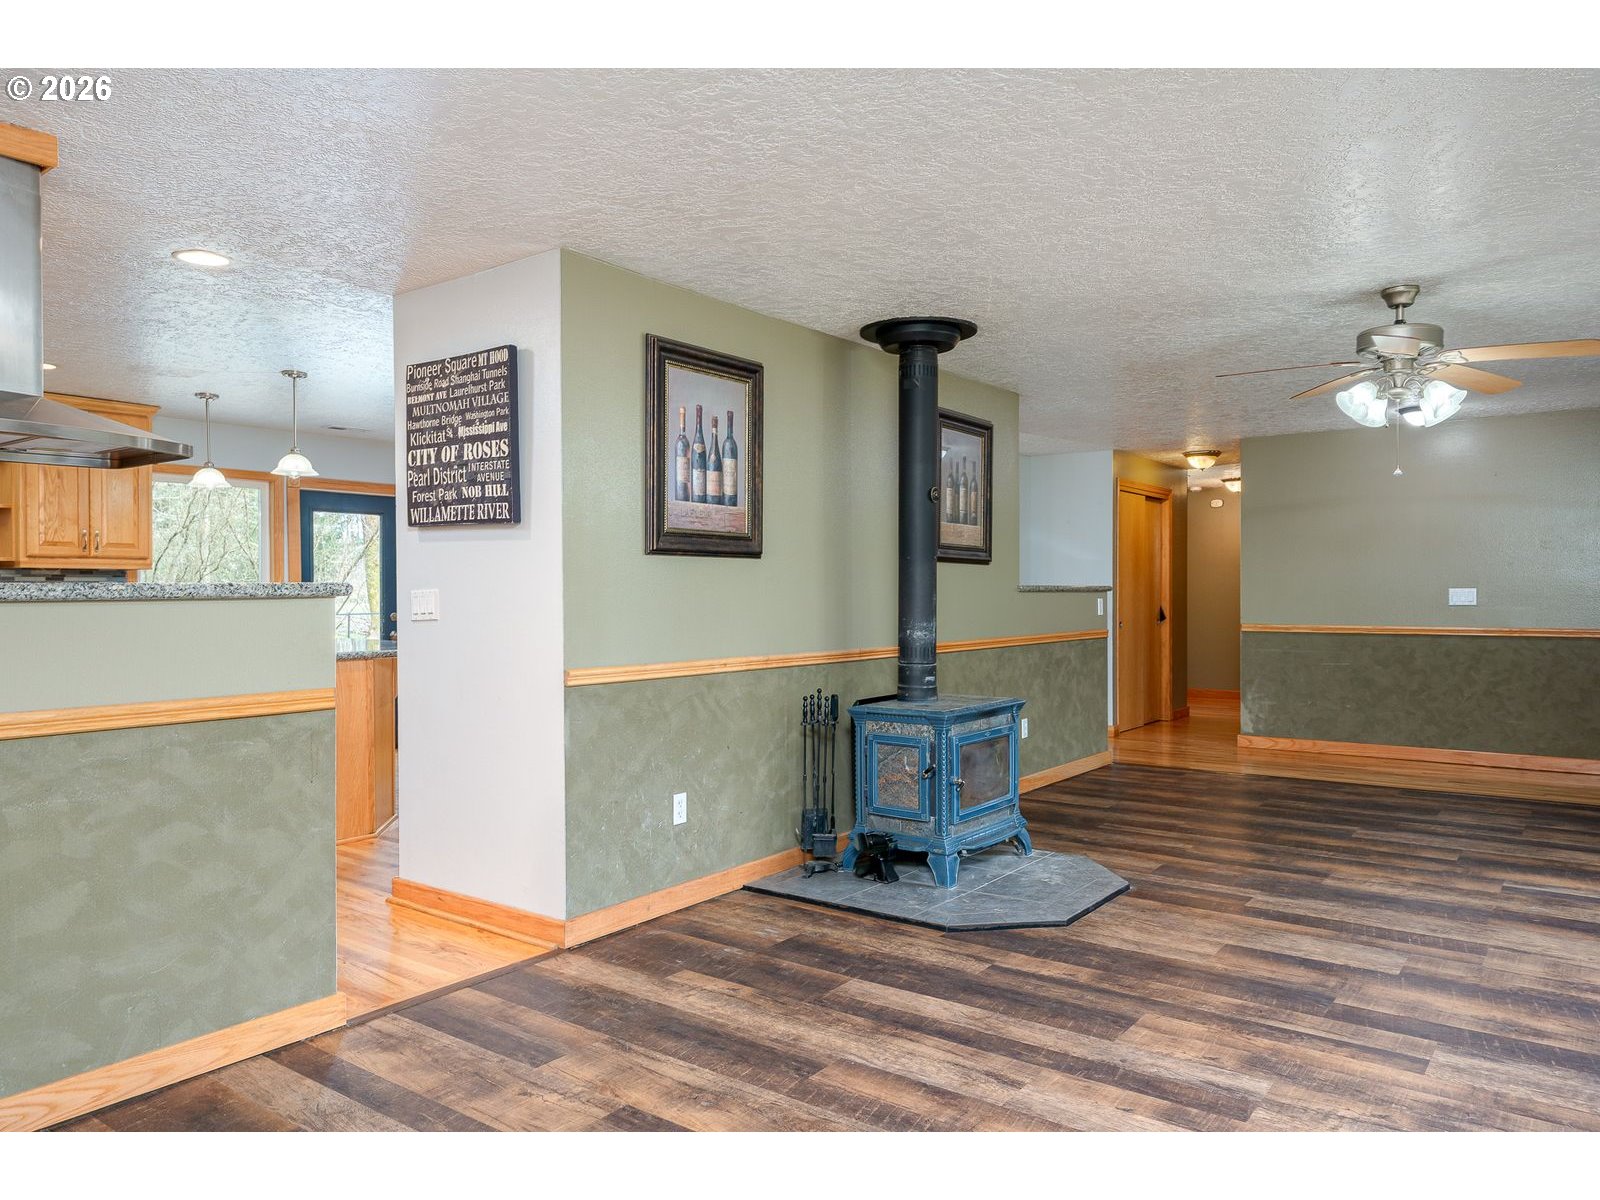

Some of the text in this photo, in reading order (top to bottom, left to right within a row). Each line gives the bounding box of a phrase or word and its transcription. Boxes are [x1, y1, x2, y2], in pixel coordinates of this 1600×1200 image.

[407, 348, 509, 380] Pioneer Square MT HOOD
[434, 376, 450, 388] Road
[450, 370, 480, 385] Shanghai
[482, 365, 508, 380] Tunnels
[407, 379, 506, 405] BELMONT AVE Laurelhurst Park
[412, 392, 510, 418] MULTNOMAH VILLAGE
[407, 407, 510, 431] Hawthorne Bridge Washington Park
[410, 430, 446, 446] Klickitat
[458, 421, 495, 439] Mississippi
[496, 421, 508, 432] Ave
[408, 438, 509, 467] CITY OF ROSES
[407, 464, 467, 488] Pearl District
[468, 459, 510, 472] INTERSTATE
[477, 471, 505, 482] AVENUE
[412, 483, 509, 503] Forest Park NOB HILL
[410, 502, 510, 524] WILLAMETTE RIVER
